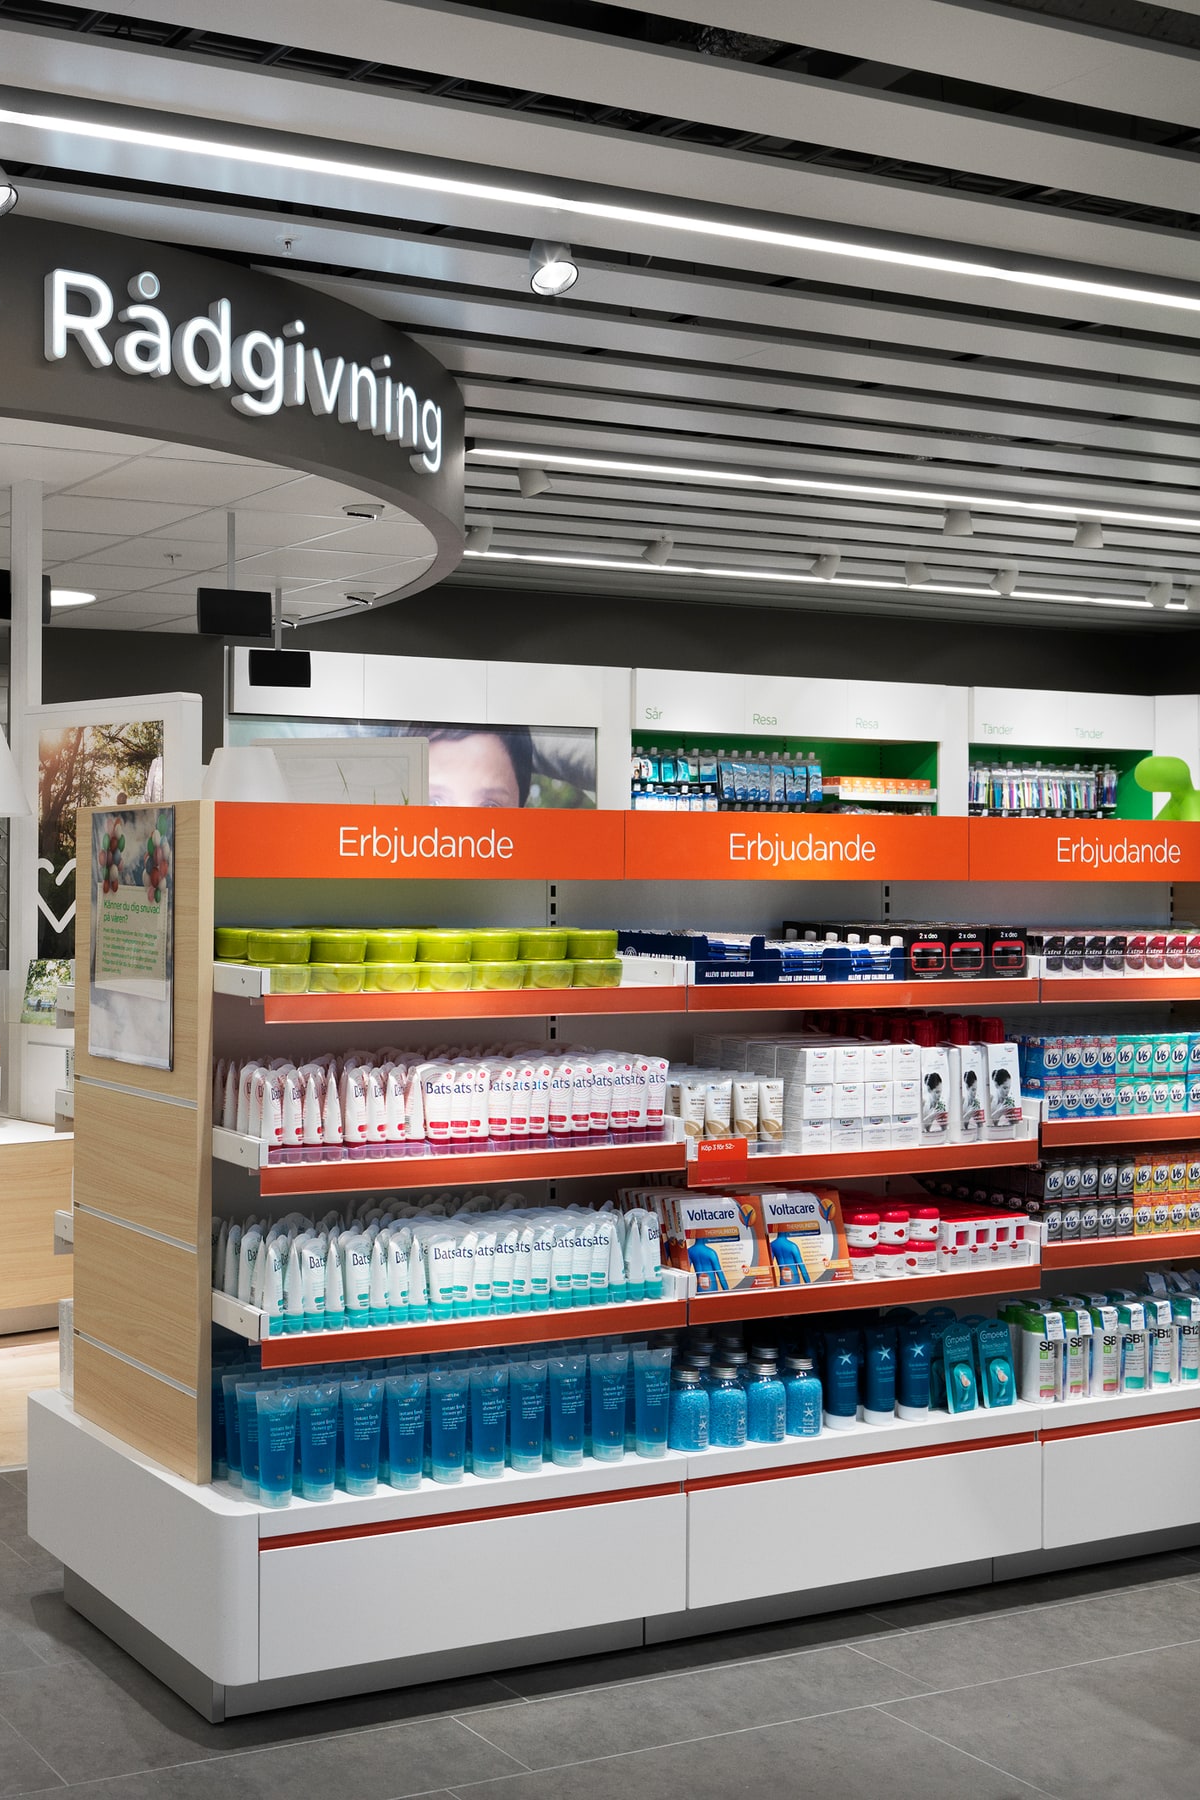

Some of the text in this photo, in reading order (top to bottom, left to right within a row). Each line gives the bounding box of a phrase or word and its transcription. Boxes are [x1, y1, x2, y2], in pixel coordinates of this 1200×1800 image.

[44, 268, 442, 474] Rådgivning
[645, 707, 663, 720] Sår
[752, 713, 777, 726] Resa
[855, 717, 879, 730] Resa
[982, 722, 1014, 735] Tänder
[1075, 727, 1103, 739] Tänder
[339, 825, 514, 863] Erbjudande
[729, 832, 876, 867] Erbjudande
[1057, 836, 1181, 868] Erbjudande
[103, 900, 122, 909] Känner
[122, 901, 130, 911] du
[131, 902, 139, 913] dig
[1047, 1053, 1058, 1065] V6
[1066, 1053, 1077, 1064] V6
[1084, 1052, 1095, 1063] V6
[1102, 1052, 1112, 1062] V6
[1119, 1051, 1130, 1062] V6
[1137, 1050, 1148, 1061] V6
[1156, 1050, 1167, 1061] V6
[1173, 1050, 1184, 1060] V6
[551, 1078, 571, 1089] ats
[573, 1077, 592, 1088] ats
[615, 1075, 631, 1086] ats
[649, 1073, 666, 1083] ats
[426, 1081, 452, 1094] Bats
[453, 1082, 472, 1094] ats
[512, 1080, 530, 1091] ats
[532, 1080, 549, 1091] ats
[701, 1144, 712, 1152] Köp
[1103, 1173, 1113, 1184] V6
[1121, 1173, 1131, 1183] V6
[1137, 1171, 1147, 1181] V6
[1155, 1170, 1165, 1180] V6
[1172, 1169, 1182, 1179] V6
[1190, 1168, 1200, 1178] V6
[1049, 1177, 1059, 1188] V6
[1065, 1175, 1076, 1186] V6
[1083, 1174, 1094, 1185] V6
[687, 1208, 735, 1221] Voltacare
[769, 1203, 816, 1216] Voltacare
[534, 1239, 552, 1251] ats
[575, 1236, 593, 1247] ats
[593, 1234, 610, 1246] ats
[455, 1246, 473, 1258] ats
[475, 1244, 494, 1257] ats
[495, 1242, 515, 1254] ats
[352, 1252, 371, 1266] Bats
[945, 1332, 971, 1347] Compeed
[980, 1328, 1008, 1343] Compeed
[1103, 1335, 1117, 1346] SB
[1125, 1333, 1143, 1344] SB1
[1039, 1341, 1055, 1351] SB
[1070, 1337, 1083, 1347] SB
